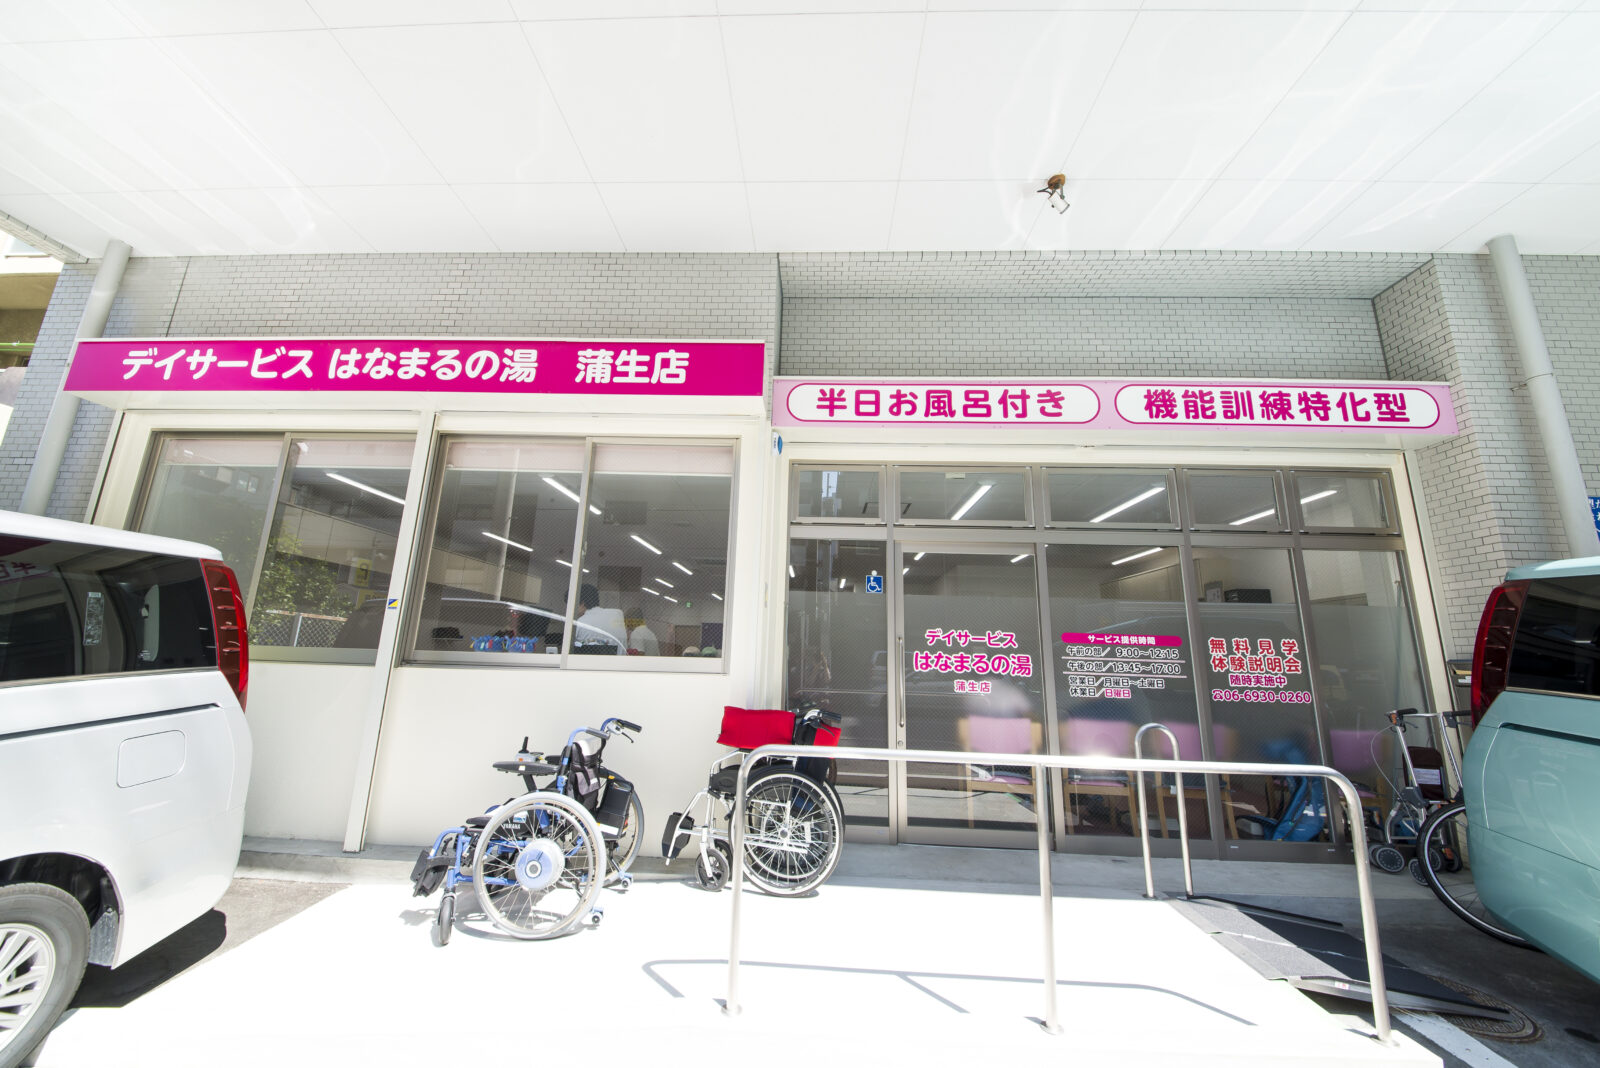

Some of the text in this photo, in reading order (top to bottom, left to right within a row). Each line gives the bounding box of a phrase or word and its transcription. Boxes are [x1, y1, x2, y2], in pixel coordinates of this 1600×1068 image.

[122, 346, 690, 386] デイサービス はなまるの湯 蒲生店
[816, 387, 1067, 420] 半日お風呂付き
[1144, 388, 1411, 424] 機能訓練特化型
[925, 628, 1018, 648] デイサービス
[1088, 634, 1156, 645] サービス提供時間
[1208, 636, 1300, 656] 無料見学
[913, 651, 1033, 677] はなまるの湯
[1210, 656, 1302, 675] 体験説明会
[954, 679, 992, 694] 蒲生店
[1229, 674, 1288, 688] 随時実施中
[1223, 689, 1312, 704] 06-6930-0260
